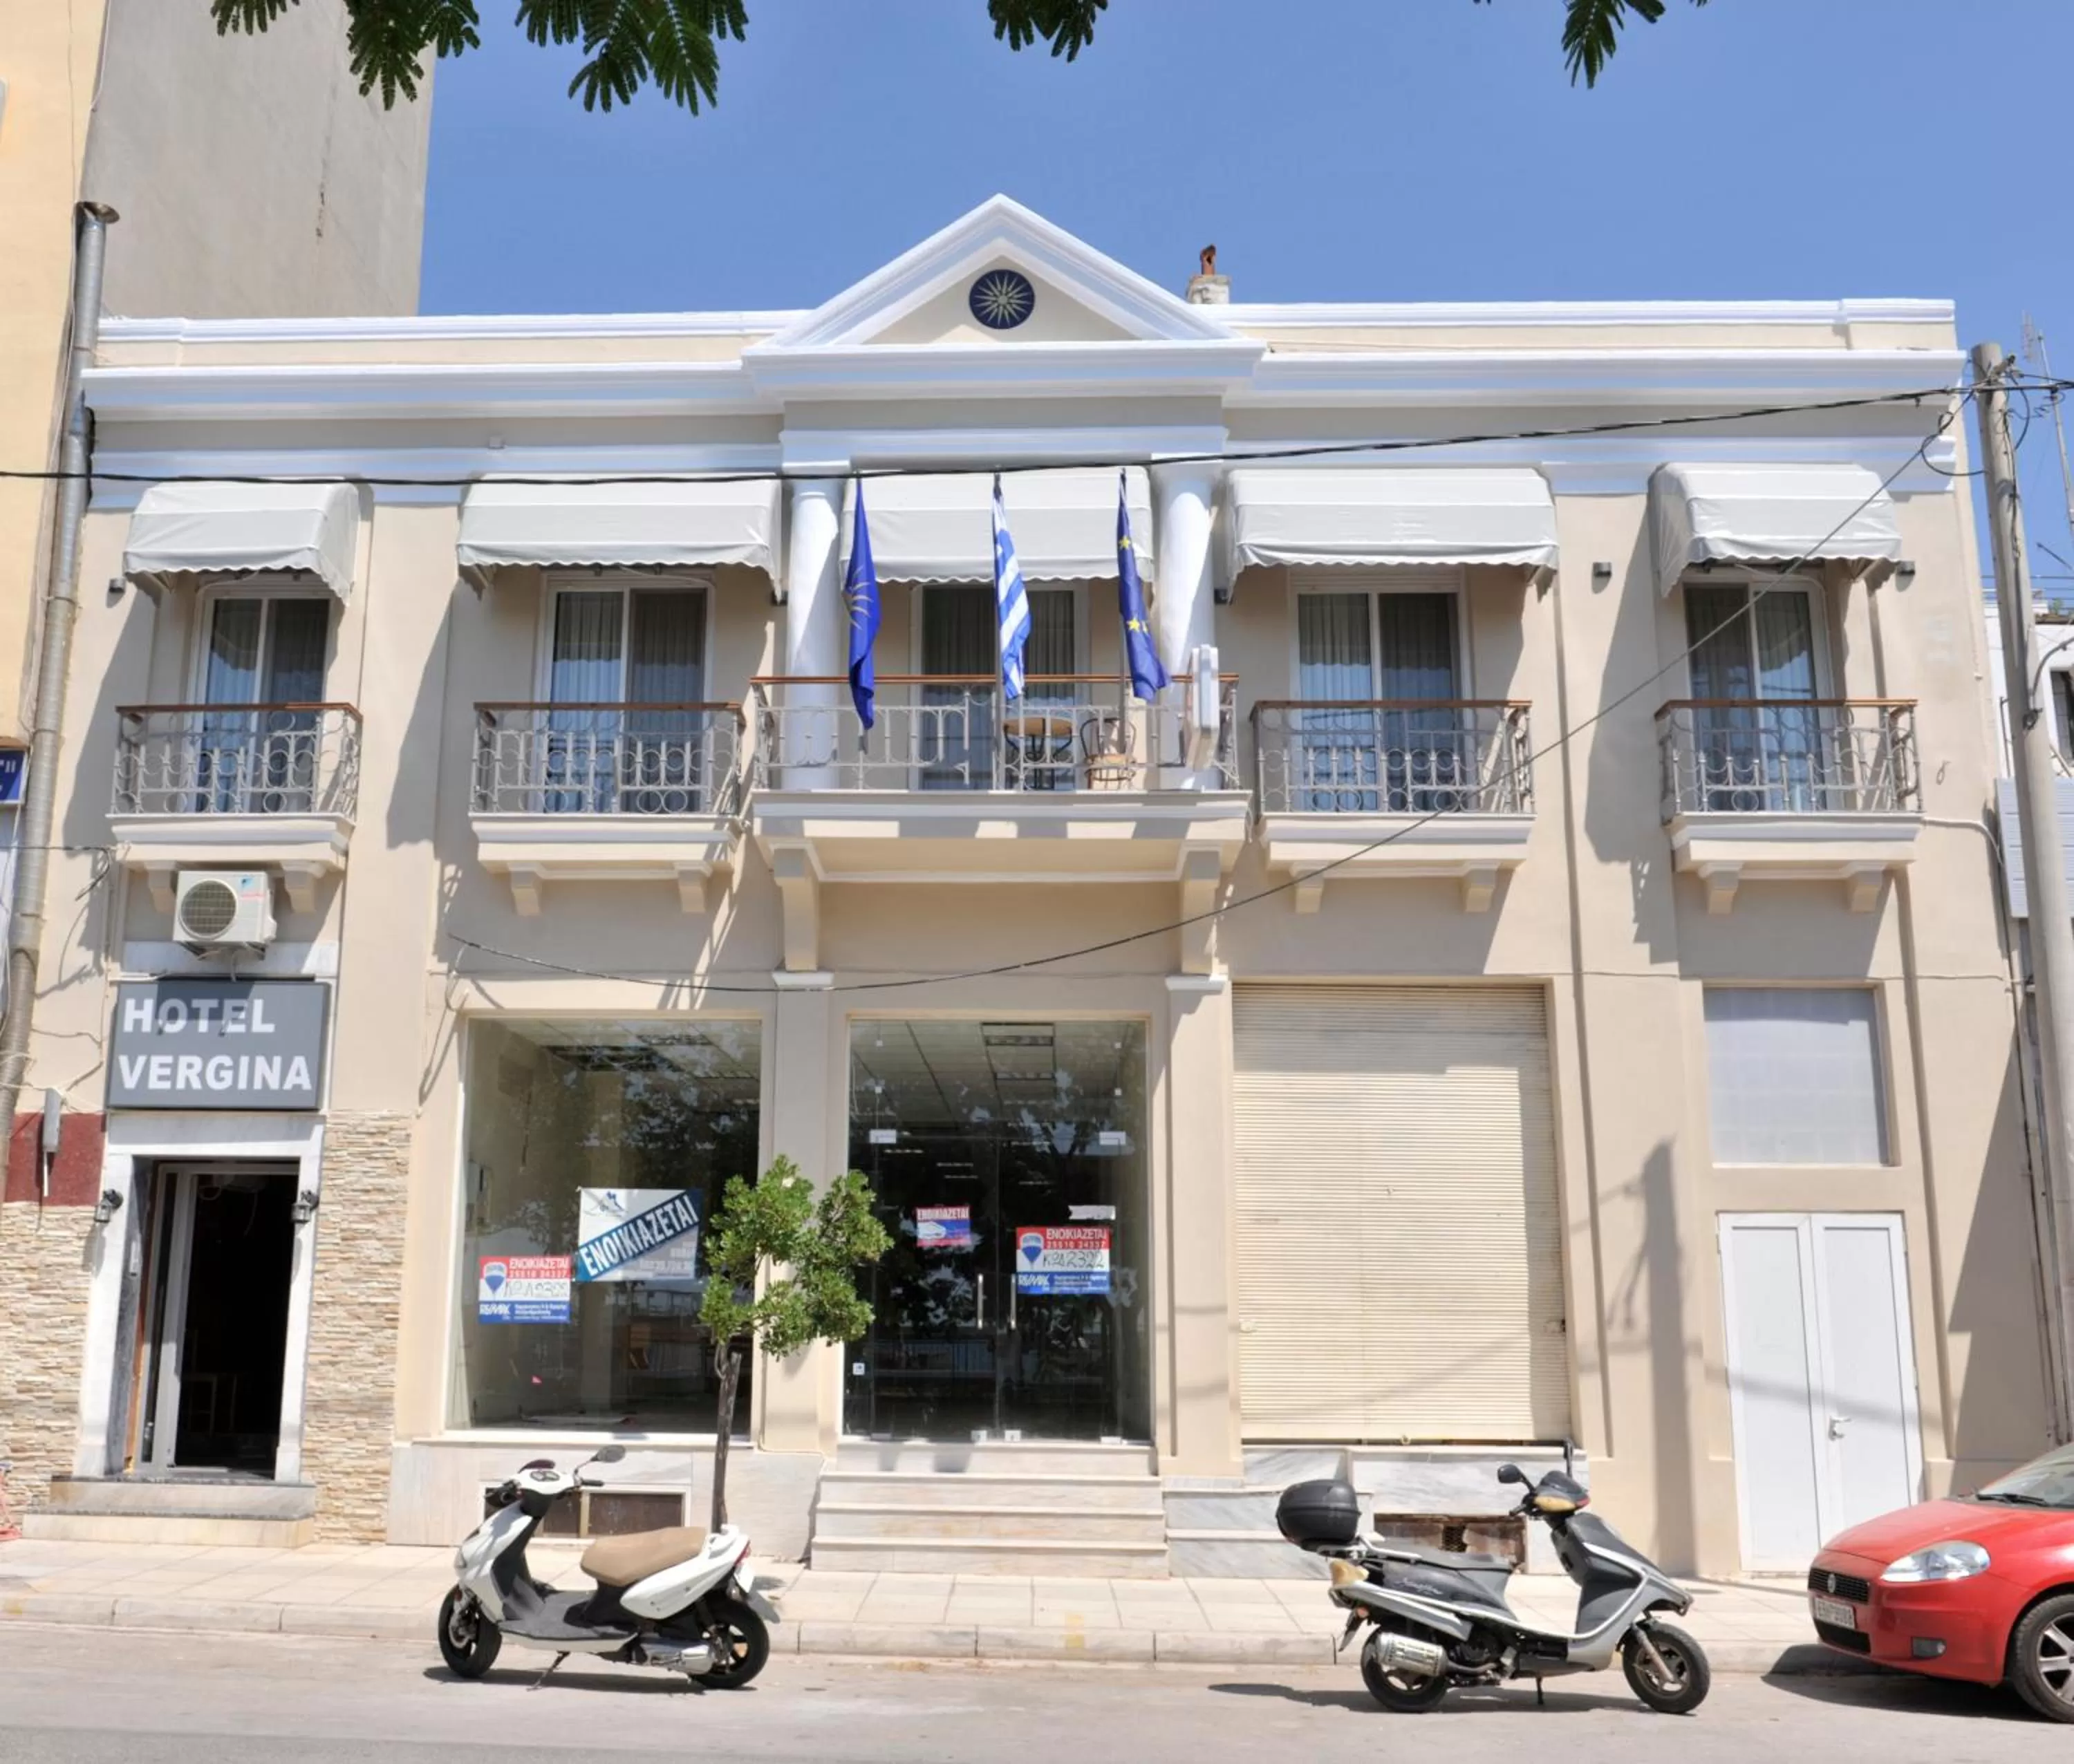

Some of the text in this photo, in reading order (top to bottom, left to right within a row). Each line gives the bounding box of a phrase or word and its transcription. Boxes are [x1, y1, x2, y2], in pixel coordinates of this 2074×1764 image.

[122, 999, 276, 1033] HOTEL
[118, 1055, 312, 1091] VERGINA
[579, 1194, 700, 1276] ΕΝΟΙΚΙΑΖΕΤΑΙ
[1046, 1228, 1107, 1239] ΕΝΟΙΚΙΑΖΕΤΑΙ
